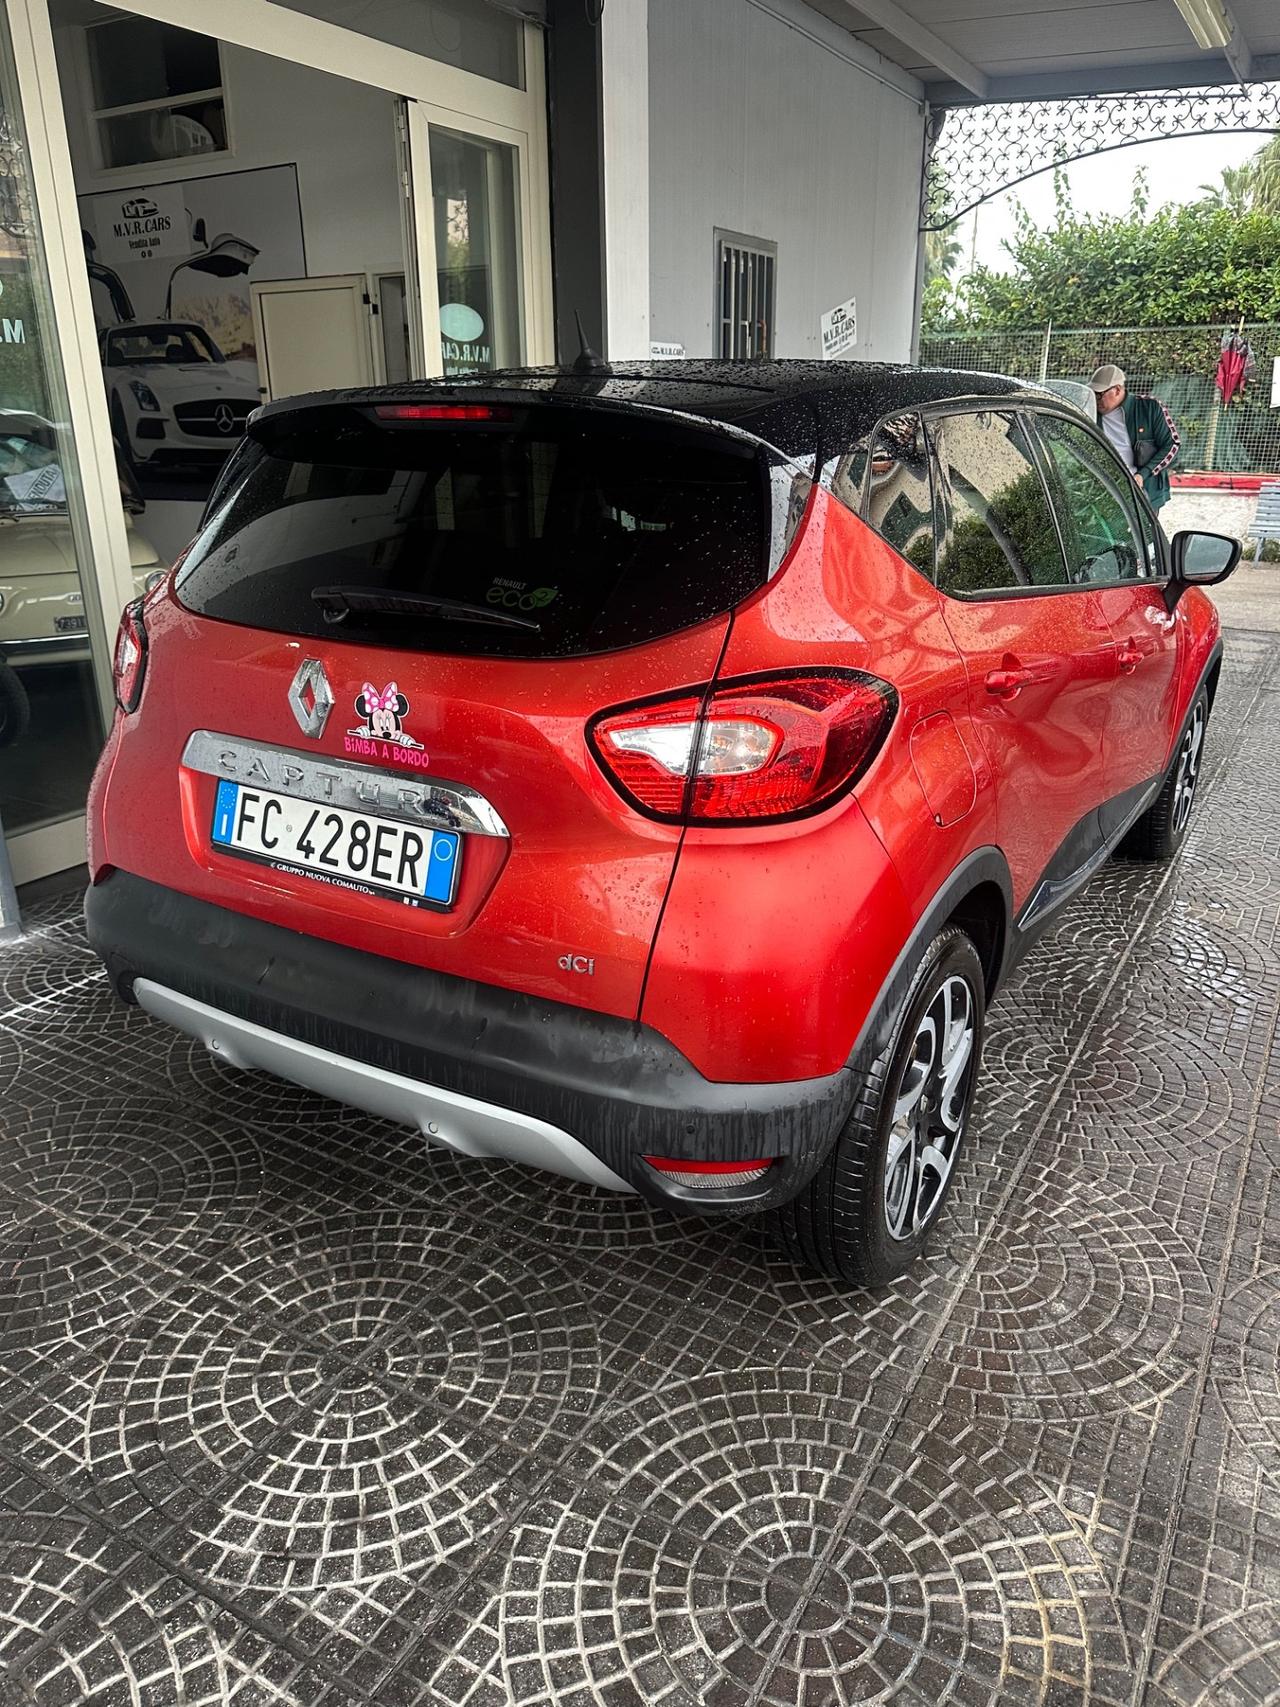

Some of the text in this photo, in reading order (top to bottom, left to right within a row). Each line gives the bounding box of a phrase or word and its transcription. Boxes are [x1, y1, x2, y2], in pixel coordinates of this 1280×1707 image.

[113, 216, 171, 238] M.V.R.CARS
[492, 577, 527, 591] RENAULT
[382, 744, 390, 759] A
[393, 746, 429, 768] BORDO
[218, 750, 424, 815] CAPTUR
[237, 792, 424, 888] FC 428ER
[276, 863, 305, 876] GRUPPO
[305, 871, 330, 884] NUOVA
[331, 878, 369, 894] COMAUTO
